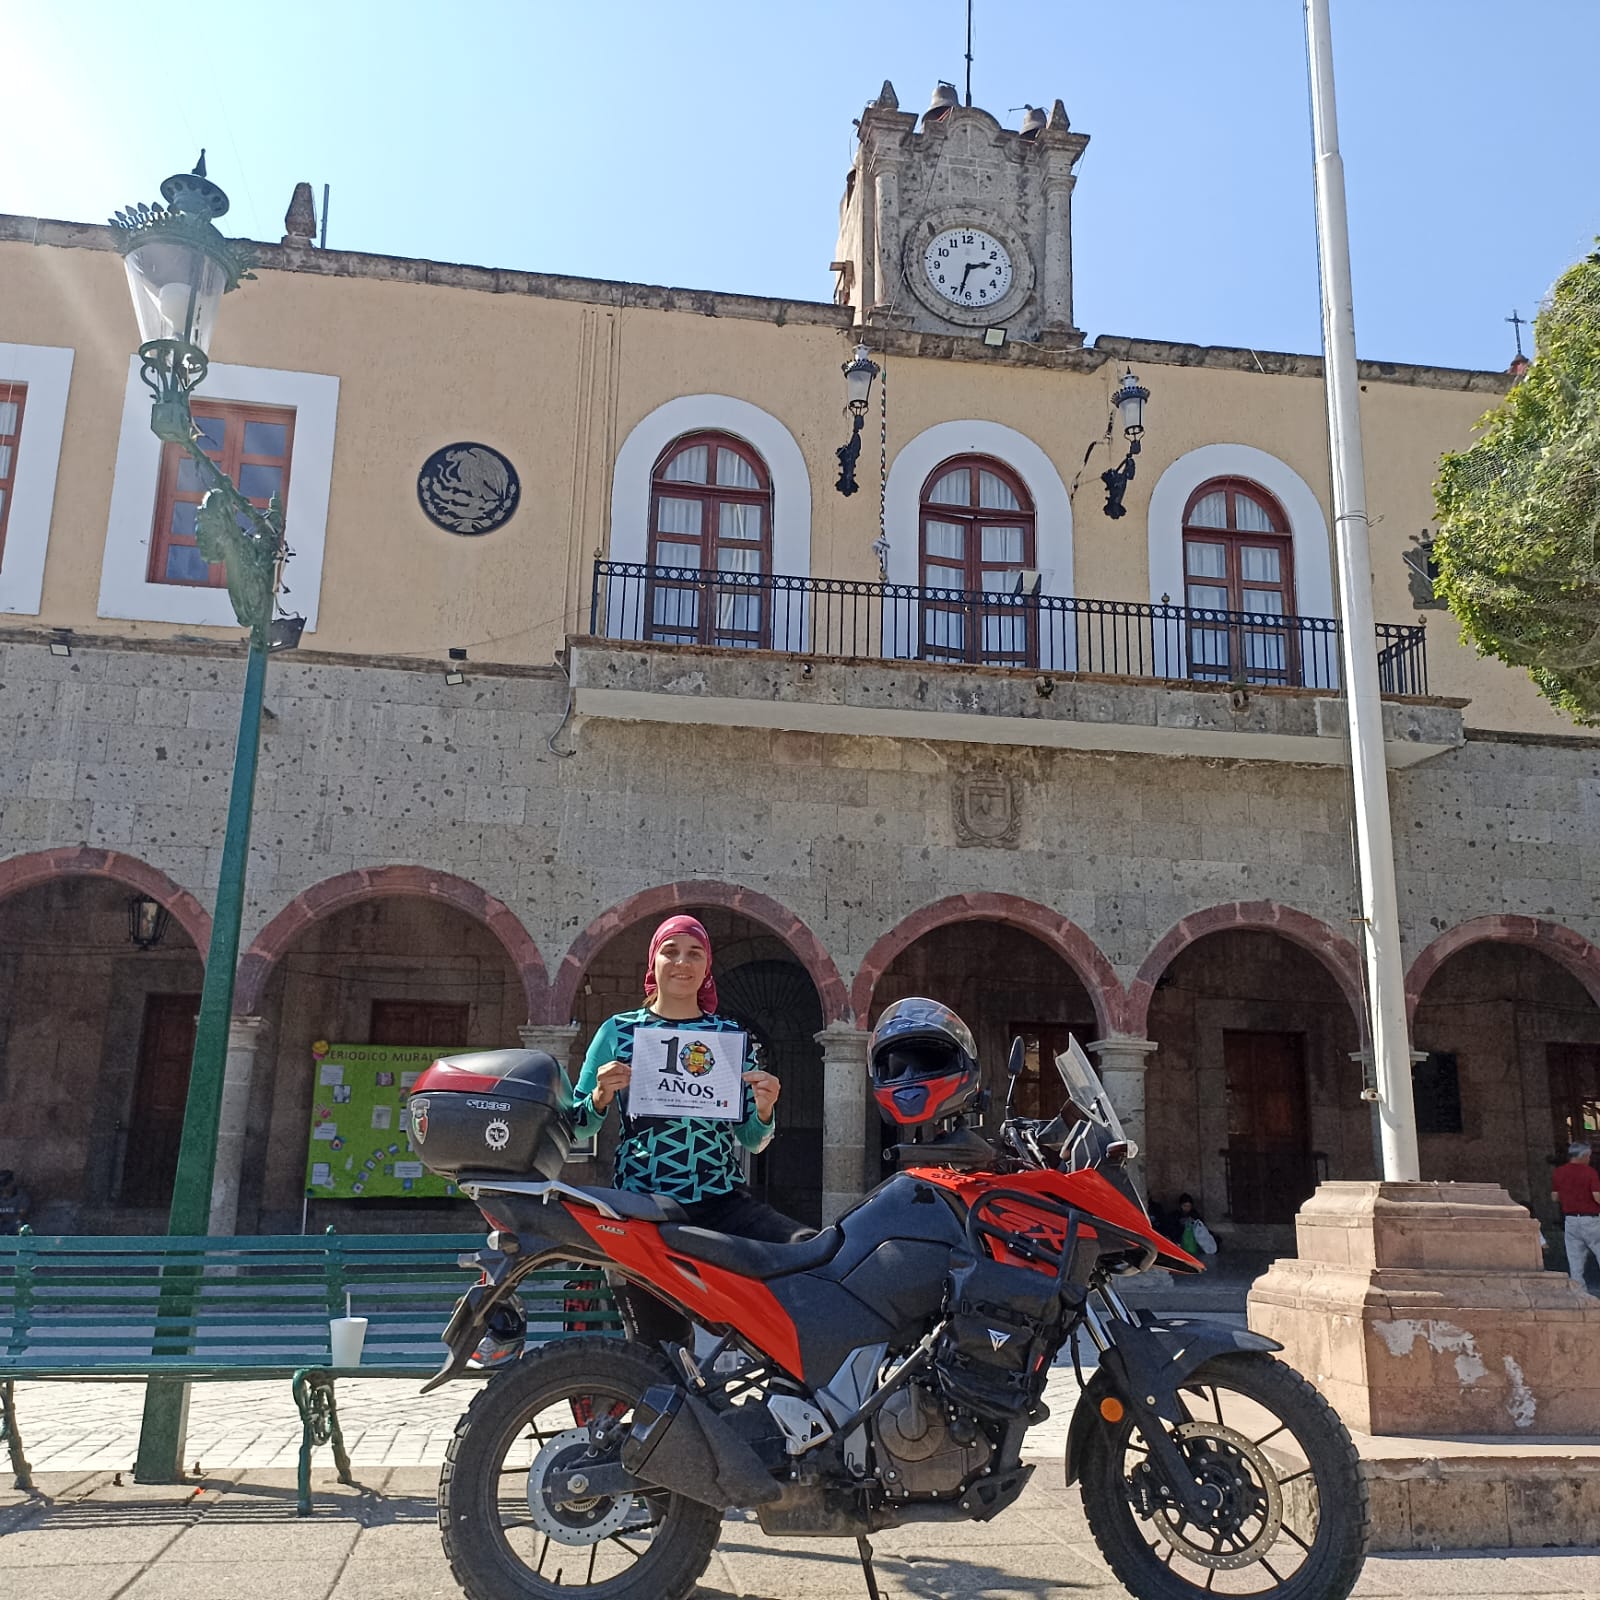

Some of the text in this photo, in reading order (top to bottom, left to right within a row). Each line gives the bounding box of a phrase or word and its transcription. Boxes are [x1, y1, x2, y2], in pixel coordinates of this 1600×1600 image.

[949, 239, 958, 248] 11
[962, 235, 974, 244] 12
[981, 241, 986, 250] 1
[938, 248, 950, 257] 10
[989, 251, 997, 260] 2
[933, 261, 941, 269] 9
[995, 266, 1002, 275] 3
[938, 275, 945, 283] 8
[989, 279, 997, 288] 4
[950, 286, 958, 295] 7
[979, 289, 986, 298] 5
[964, 291, 972, 300] 6
[330, 1050, 388, 1062] ERIODICO
[392, 1052, 434, 1063] MURAL
[657, 1076, 714, 1099] AÑOS
